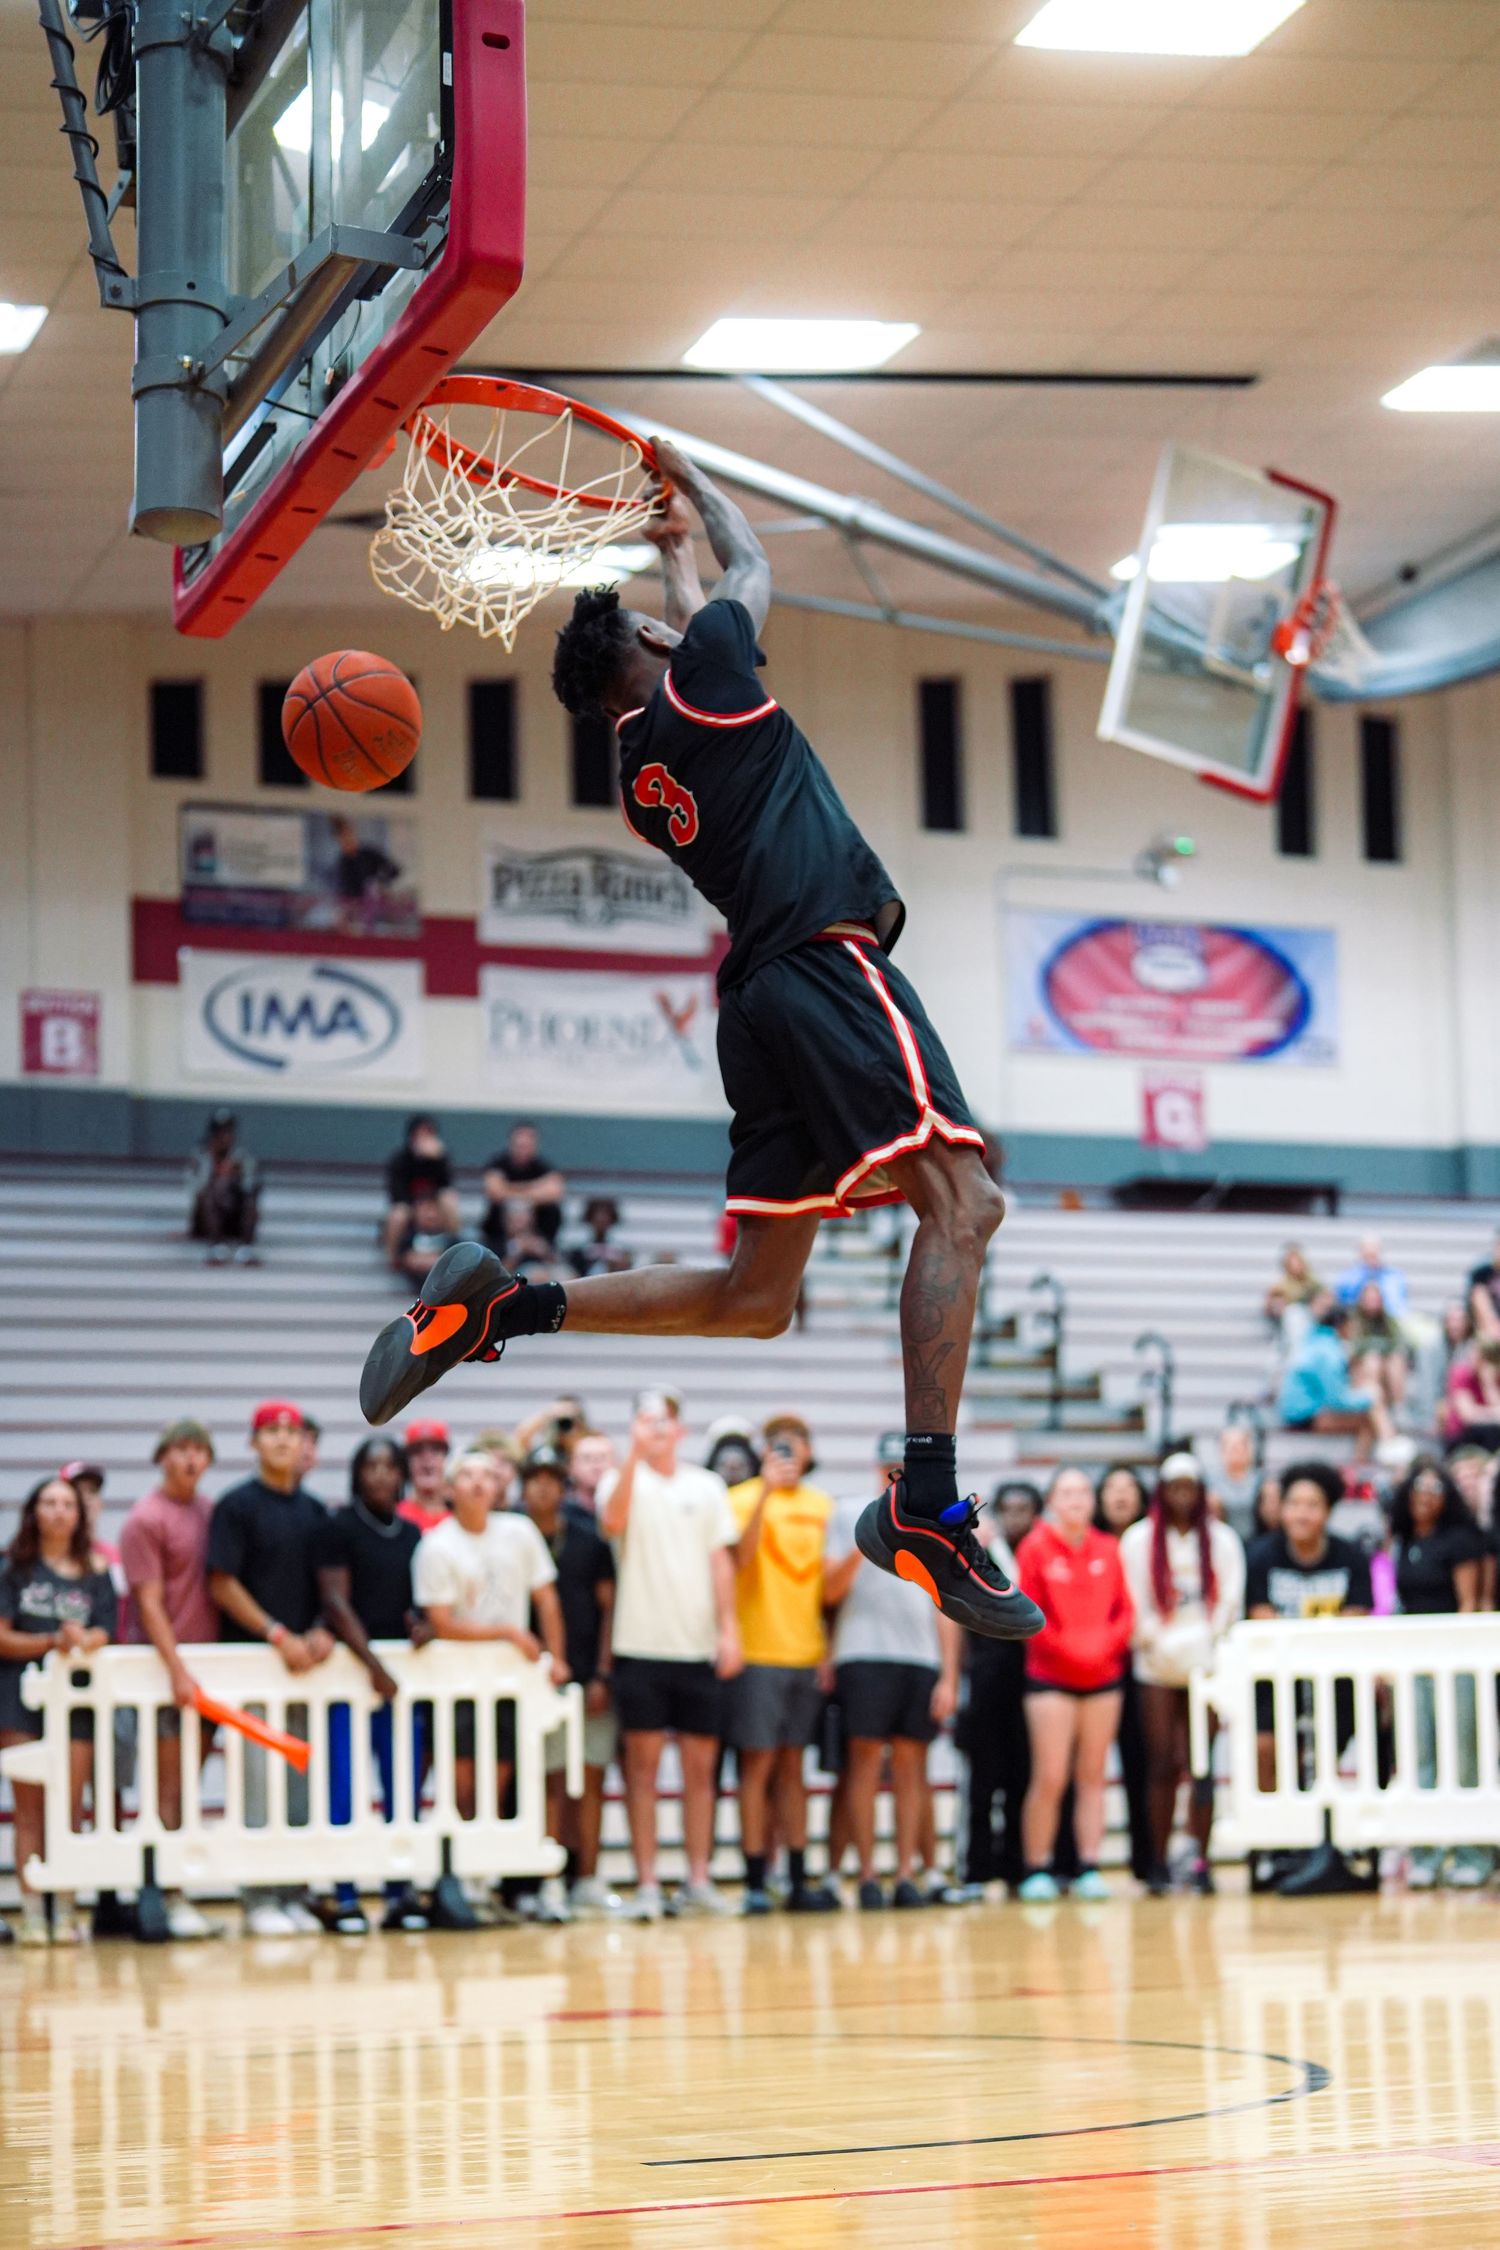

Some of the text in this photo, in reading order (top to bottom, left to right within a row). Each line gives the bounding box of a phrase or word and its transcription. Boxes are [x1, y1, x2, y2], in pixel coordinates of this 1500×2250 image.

[632, 762, 699, 847] 3
[41, 1017, 81, 1066] B
[241, 993, 370, 1042] IMA
